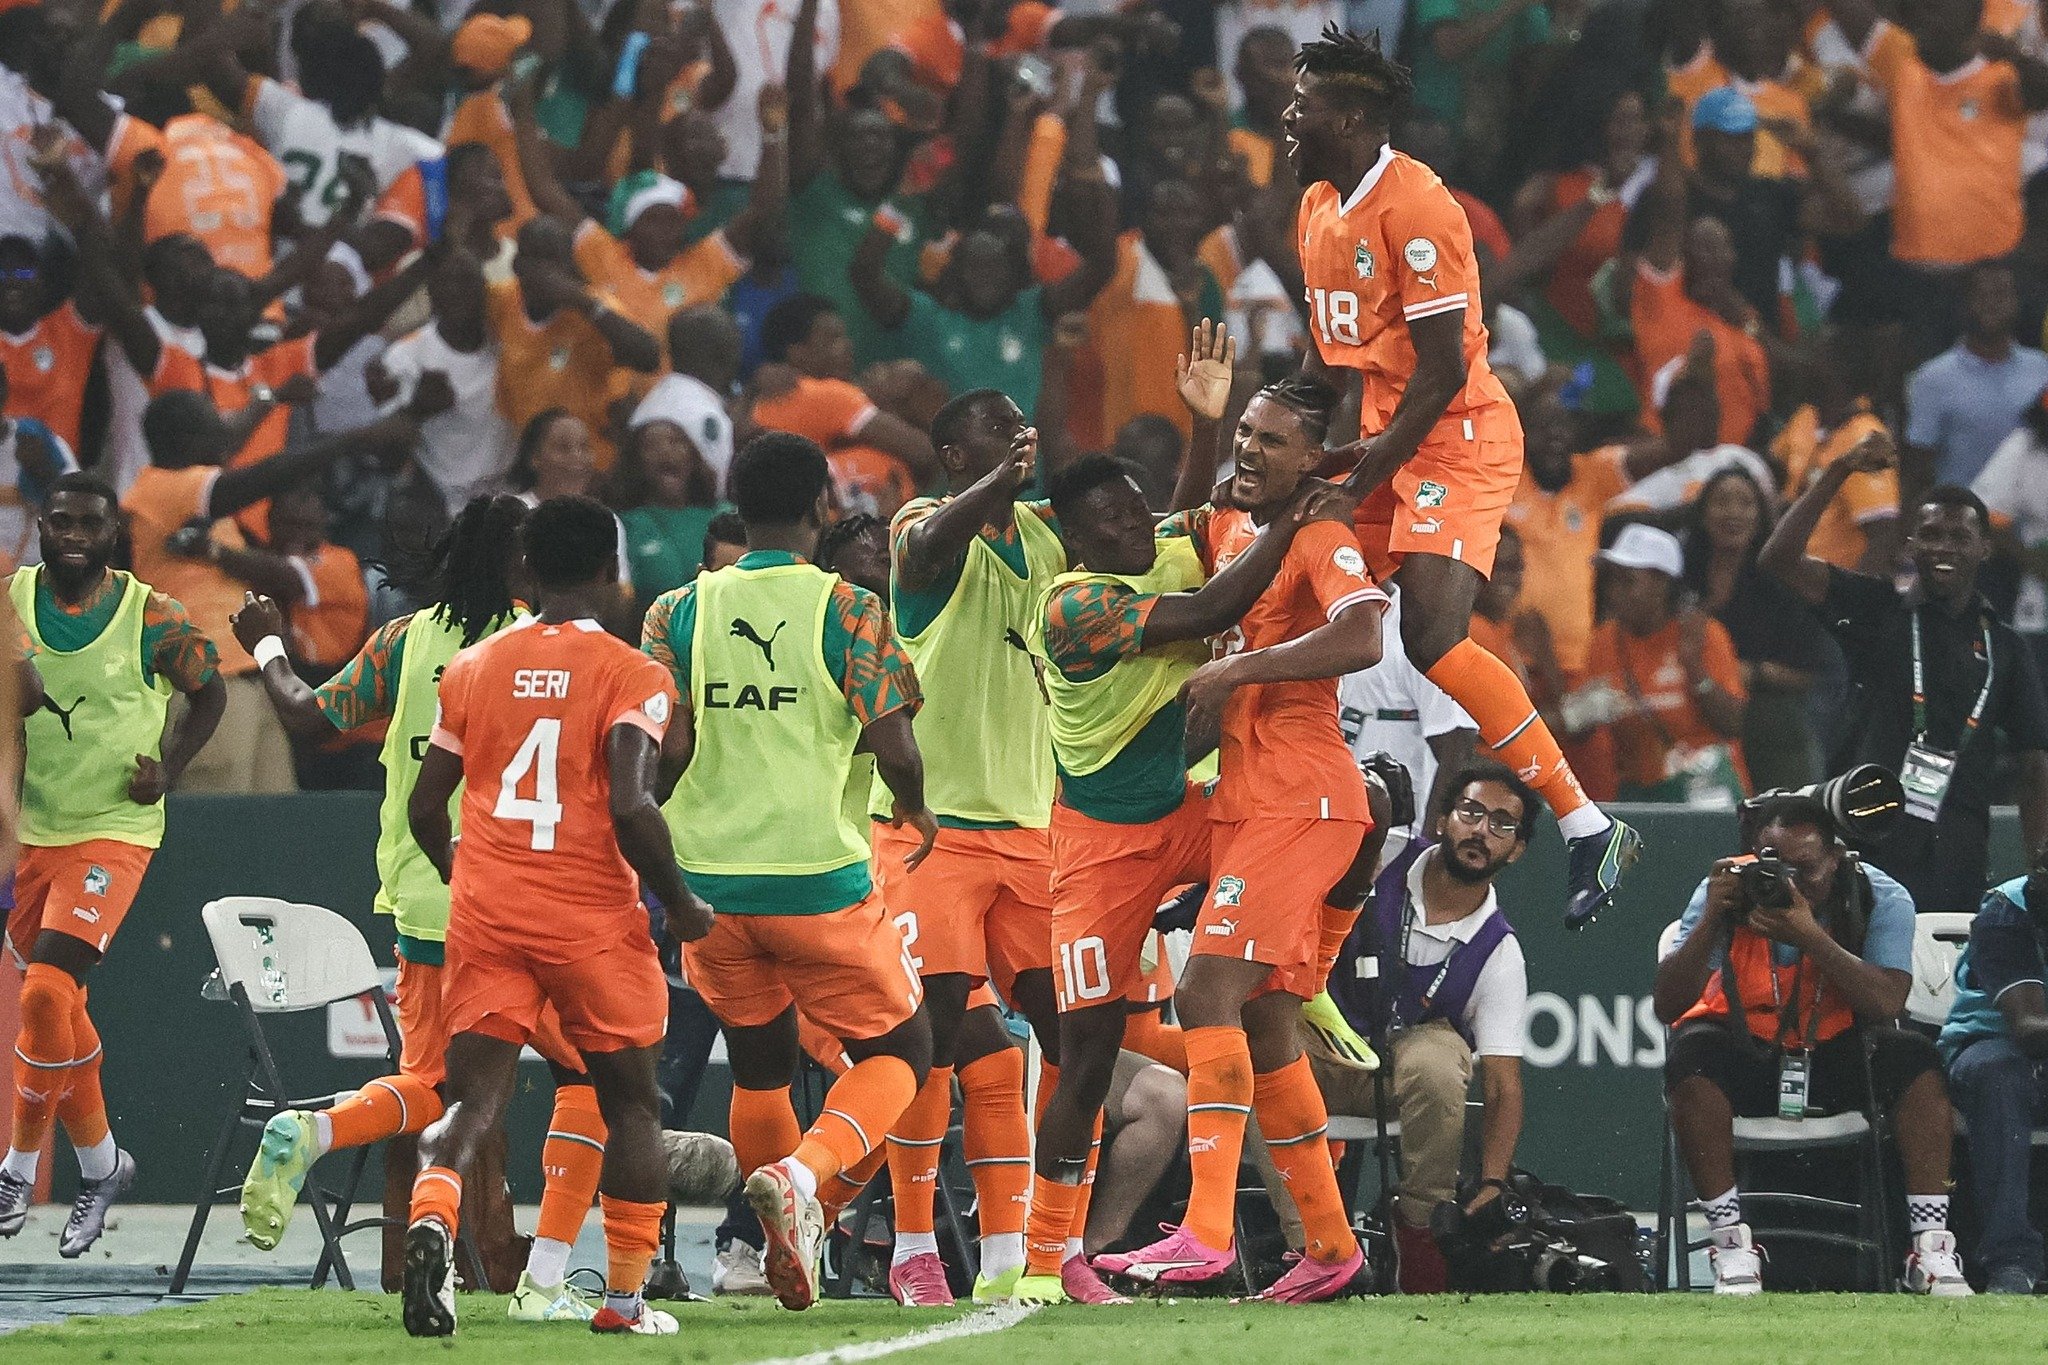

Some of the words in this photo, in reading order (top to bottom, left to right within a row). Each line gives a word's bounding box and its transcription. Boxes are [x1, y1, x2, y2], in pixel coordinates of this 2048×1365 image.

[1313, 288, 1363, 346] 18
[512, 669, 571, 699] SERI
[704, 682, 797, 711] CAF
[492, 717, 563, 851] 4
[1060, 936, 1111, 1004] 10
[544, 1165, 567, 1177] FIF
